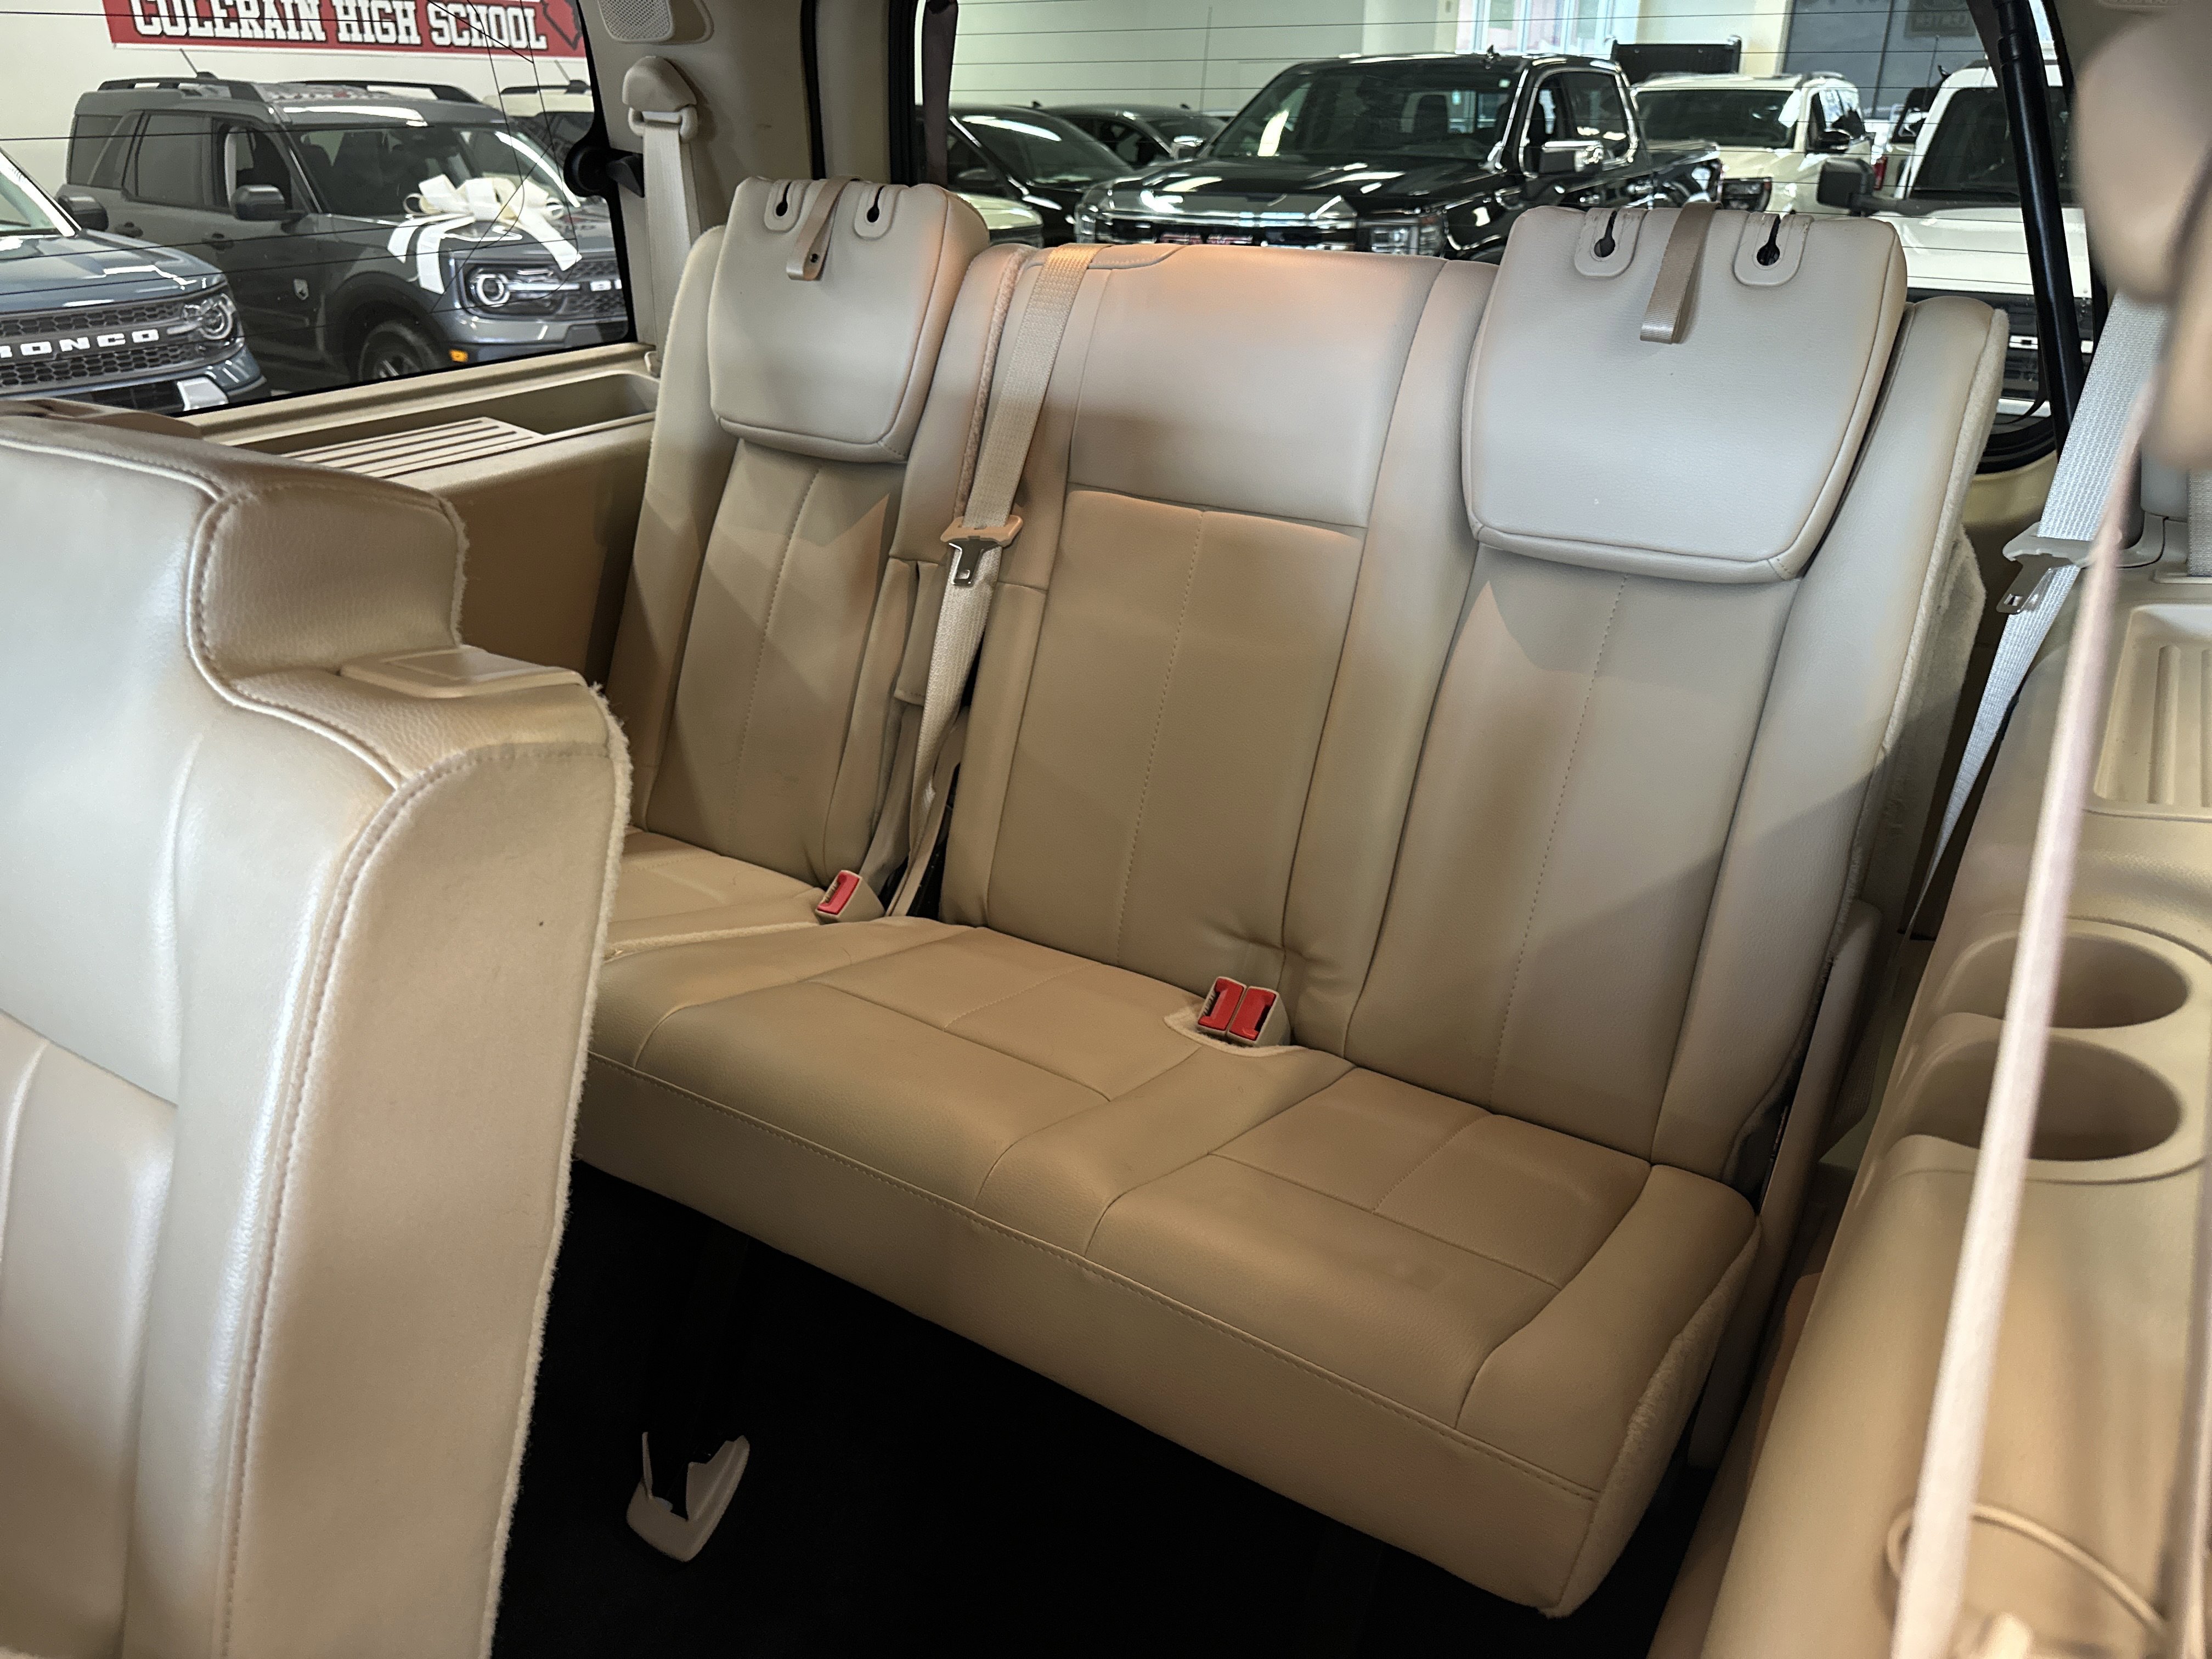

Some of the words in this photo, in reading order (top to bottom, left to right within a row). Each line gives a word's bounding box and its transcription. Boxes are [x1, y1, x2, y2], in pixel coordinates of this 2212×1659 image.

[131, 0, 327, 42] COLERAIN
[332, 1, 421, 45] HIGH
[427, 3, 548, 50] SCHOOL
